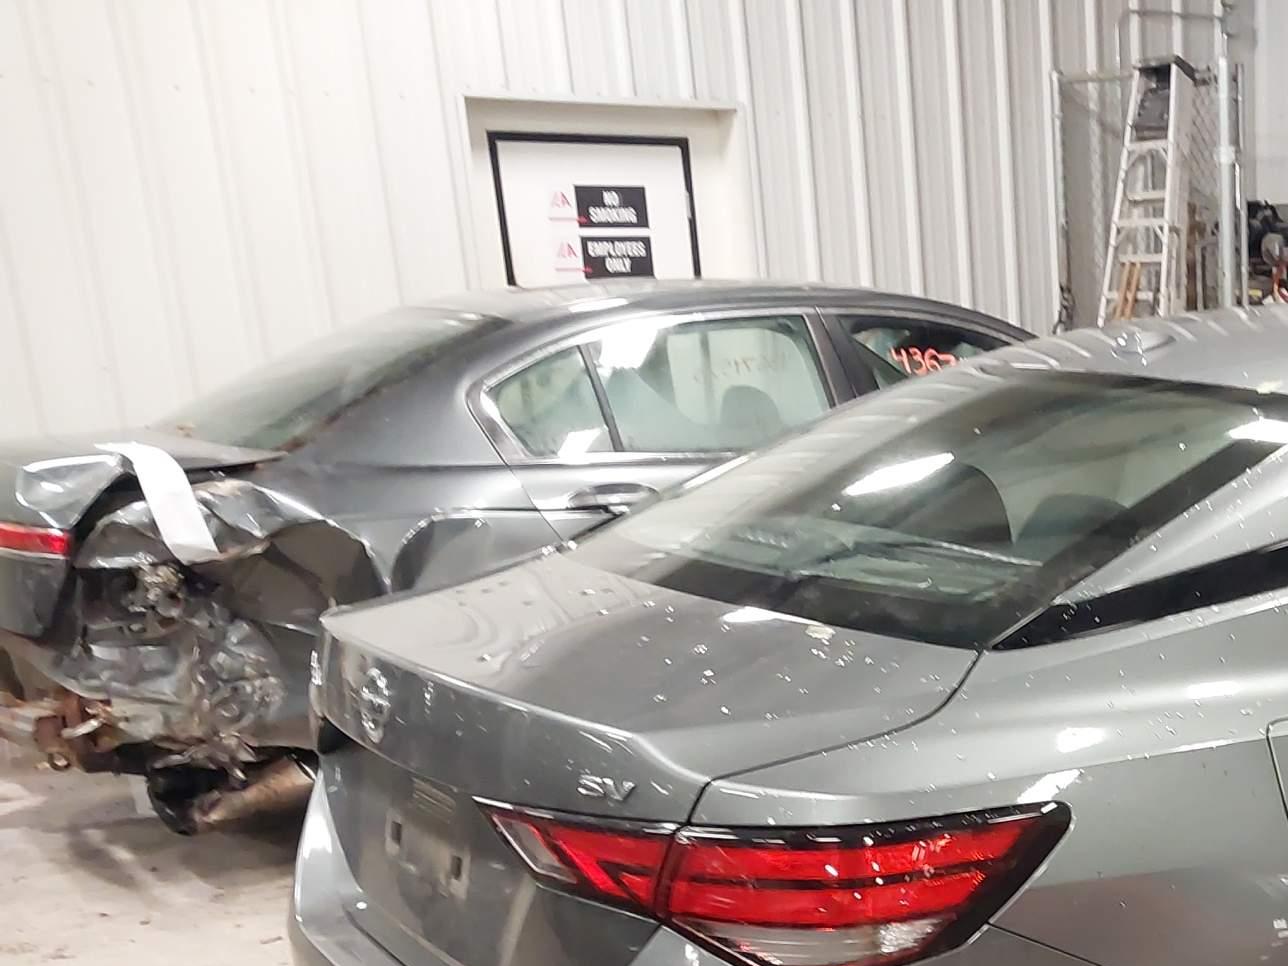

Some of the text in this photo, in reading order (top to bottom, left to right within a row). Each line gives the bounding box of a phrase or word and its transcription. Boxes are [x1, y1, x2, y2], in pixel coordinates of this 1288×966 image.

[602, 190, 619, 207] NO
[588, 206, 638, 224] SMOKING
[586, 240, 647, 258] EMPLOYEES
[605, 256, 632, 274] ONLY
[577, 774, 636, 801] SV
